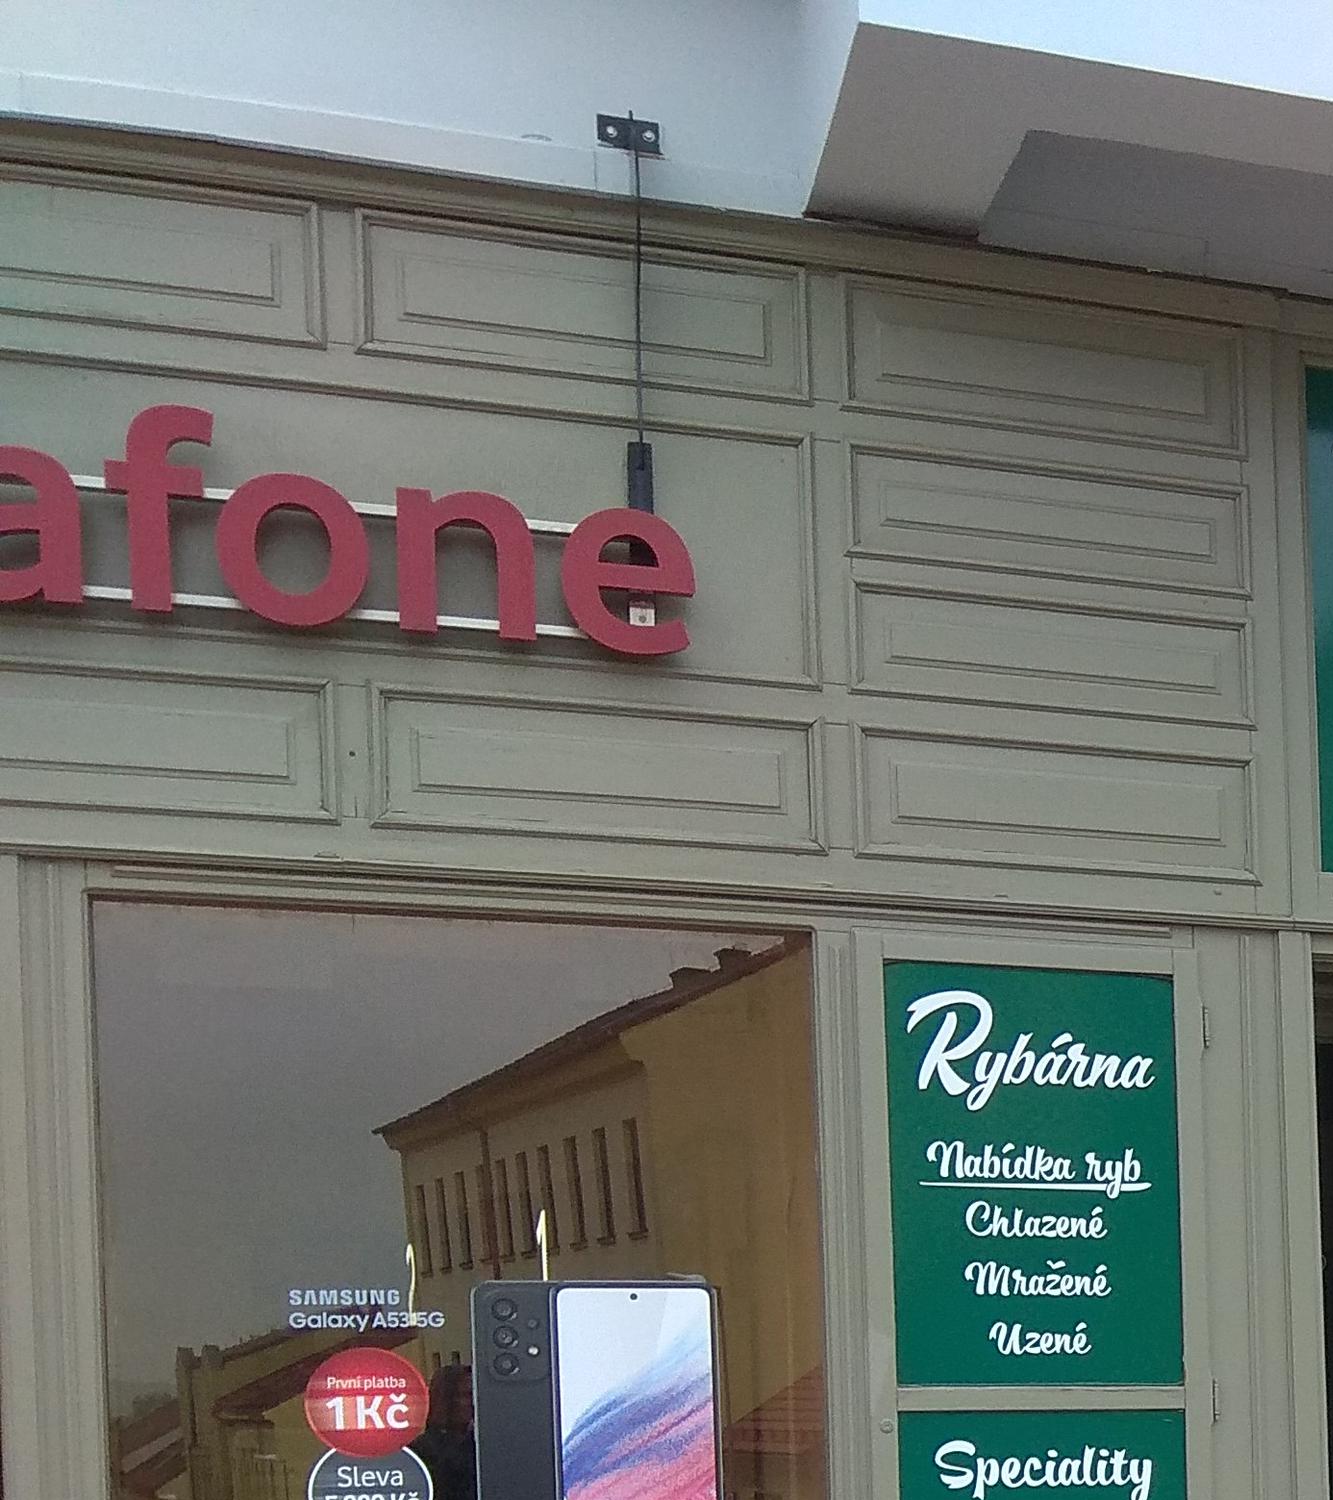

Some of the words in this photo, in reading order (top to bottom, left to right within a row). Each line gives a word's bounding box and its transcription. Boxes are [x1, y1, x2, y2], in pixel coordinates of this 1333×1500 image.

[906, 989, 1155, 1111] Rybárna
[926, 1140, 1076, 1182] Nabídka
[1085, 1148, 1142, 1199] ryb
[964, 1201, 1107, 1240] Chlazené
[963, 1259, 1112, 1298] Mražené
[288, 1288, 401, 1306] SAMSUNG
[288, 1312, 369, 1332] Galaxy
[988, 1321, 1091, 1356] Uzené
[326, 1376, 362, 1389] První
[363, 1376, 406, 1391] platba
[325, 1399, 346, 1431] 1
[355, 1393, 410, 1431] Kč
[337, 1465, 404, 1488] Sleva
